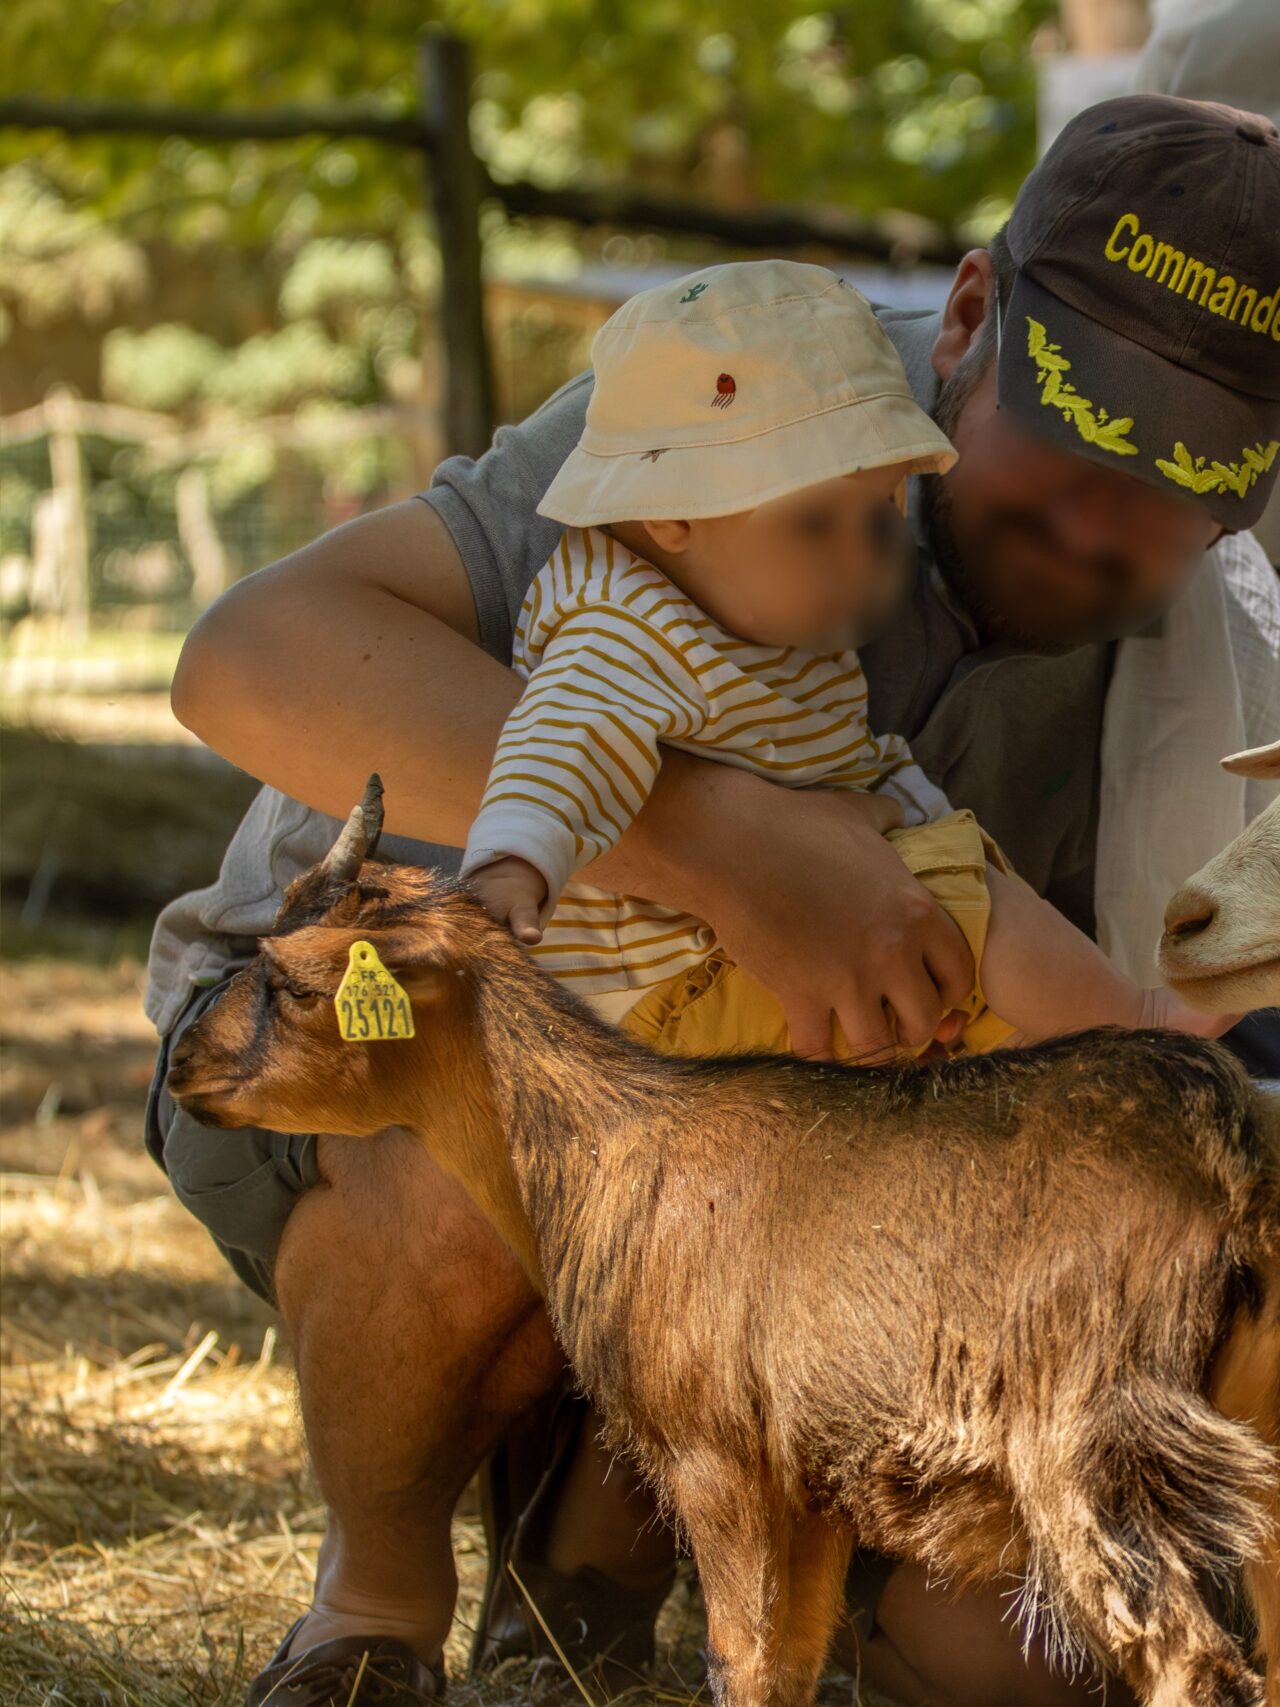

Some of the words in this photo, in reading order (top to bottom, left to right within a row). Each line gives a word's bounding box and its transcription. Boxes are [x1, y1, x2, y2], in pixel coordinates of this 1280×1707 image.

[361, 971, 377, 983] FR
[345, 985, 369, 998] 176
[342, 998, 410, 1038] 25121
